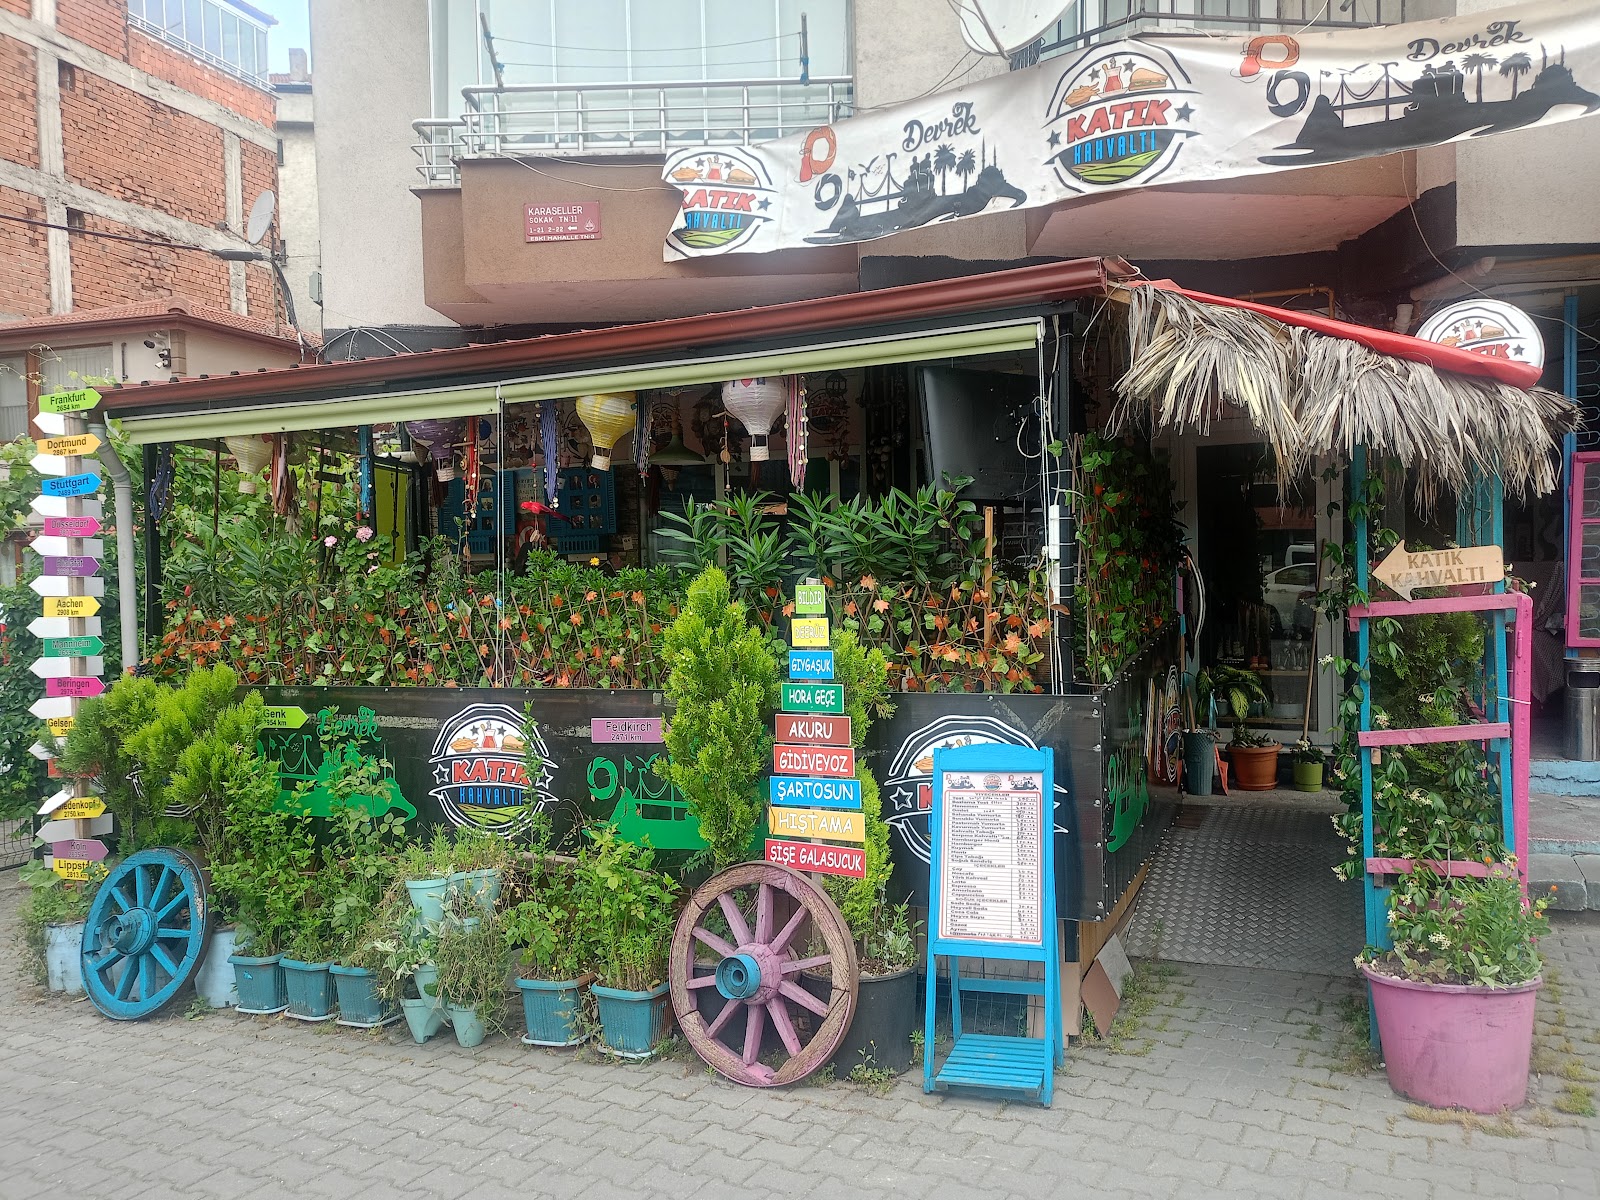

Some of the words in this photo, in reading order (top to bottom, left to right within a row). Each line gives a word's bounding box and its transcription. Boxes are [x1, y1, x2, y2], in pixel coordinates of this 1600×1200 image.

[1406, 20, 1533, 61] Devrek
[902, 102, 981, 152] Devrek
[1066, 99, 1172, 144] KATIK
[1074, 130, 1156, 165] KAHVALTI
[528, 205, 583, 216] KARASELLER
[529, 216, 554, 224] SOKAK
[686, 212, 742, 230] AHVALTI
[50, 392, 86, 405] Frankfurt
[47, 436, 87, 450] Dortmund
[50, 476, 90, 490] Stuttgart
[1407, 550, 1464, 570] KATIK
[1390, 566, 1485, 588] KAHVALTI
[56, 598, 84, 608] Aachen
[52, 639, 91, 649] Mannheim
[57, 678, 90, 690] Beringen
[788, 688, 812, 704] HORA
[814, 689, 836, 708] GEÇE
[263, 709, 287, 719] Genk
[605, 721, 653, 732] Feldkirch
[789, 721, 833, 739] AKURU
[611, 733, 628, 741] 2471
[630, 733, 642, 741] km
[779, 750, 849, 773] GİDİVEYOZ
[459, 787, 522, 805] KAHVALTI
[777, 781, 854, 801] ŞARTOSUN
[778, 811, 854, 834] HIŞTAMA
[799, 847, 862, 872] GALASUCUK
